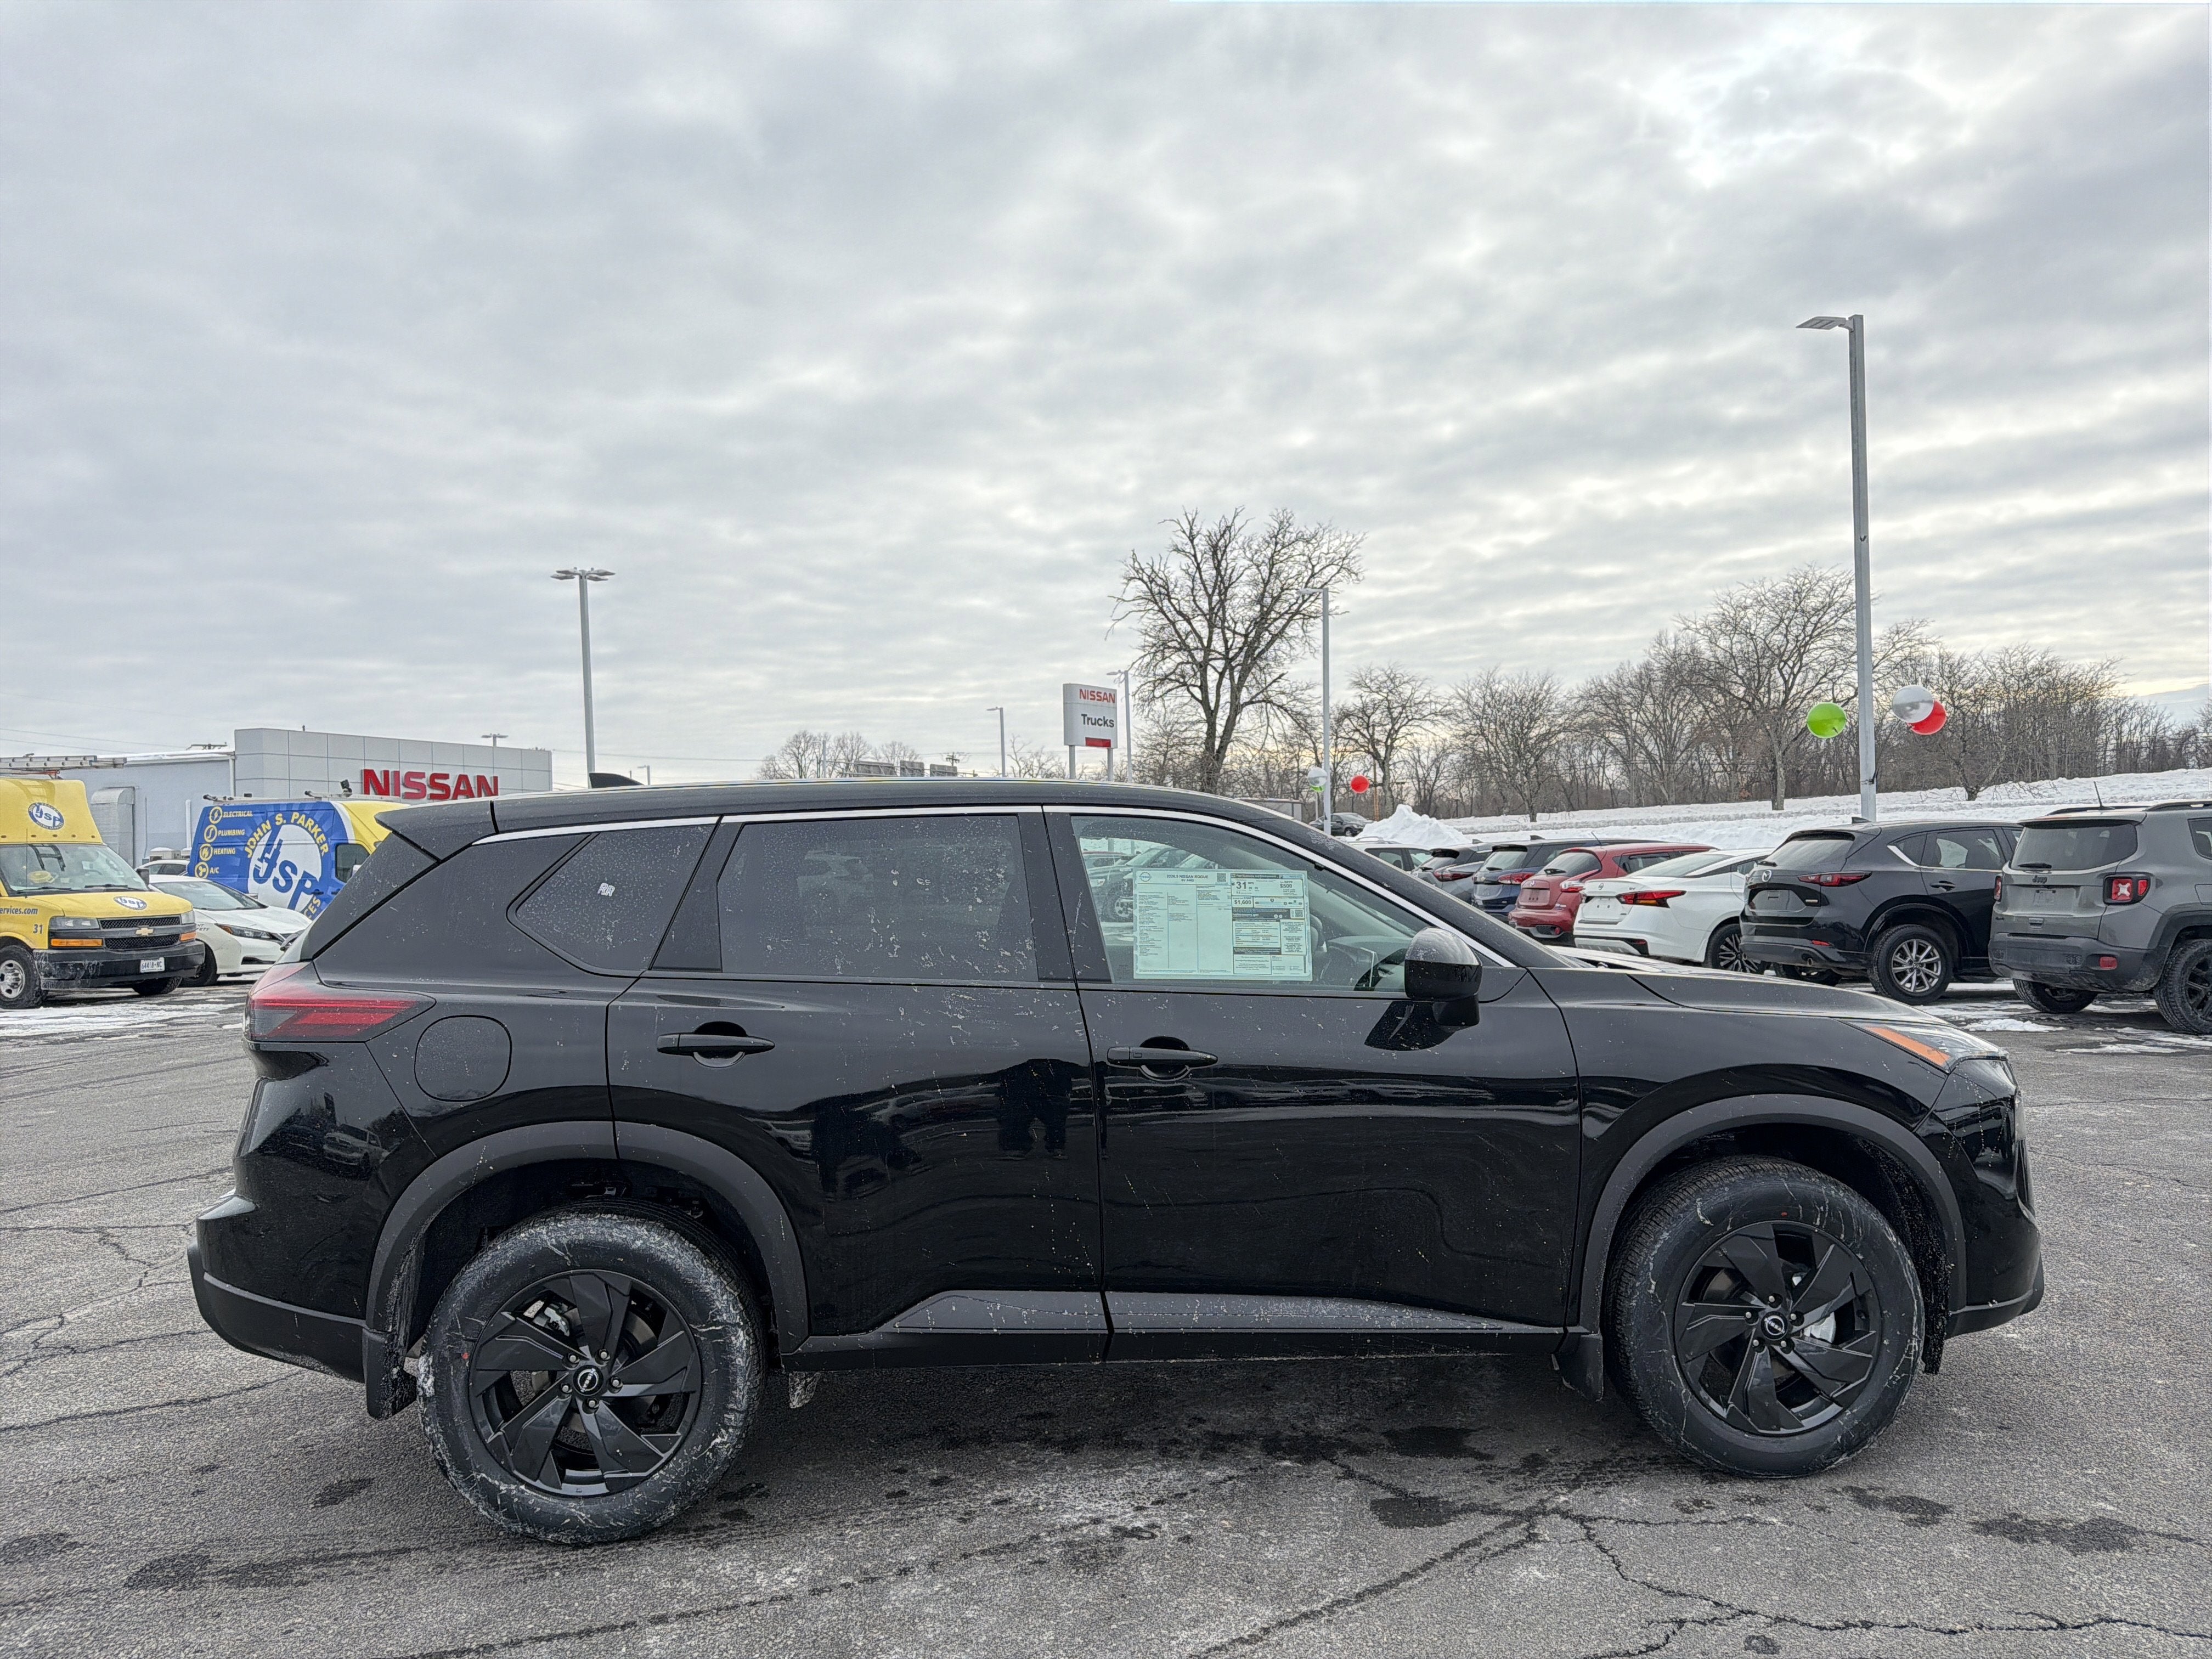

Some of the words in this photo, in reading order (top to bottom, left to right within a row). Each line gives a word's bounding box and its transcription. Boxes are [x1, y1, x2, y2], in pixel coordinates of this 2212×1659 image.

[1079, 689, 1115, 703] NISSAN
[1081, 714, 1114, 728] Trucks
[363, 769, 499, 800] NISSAN
[245, 820, 272, 859] JOHN
[275, 814, 286, 825] S.
[291, 811, 329, 857] PARKER
[1236, 881, 1246, 889] 31
[2032, 875, 2047, 883] Jeep
[33, 924, 43, 934] 31
